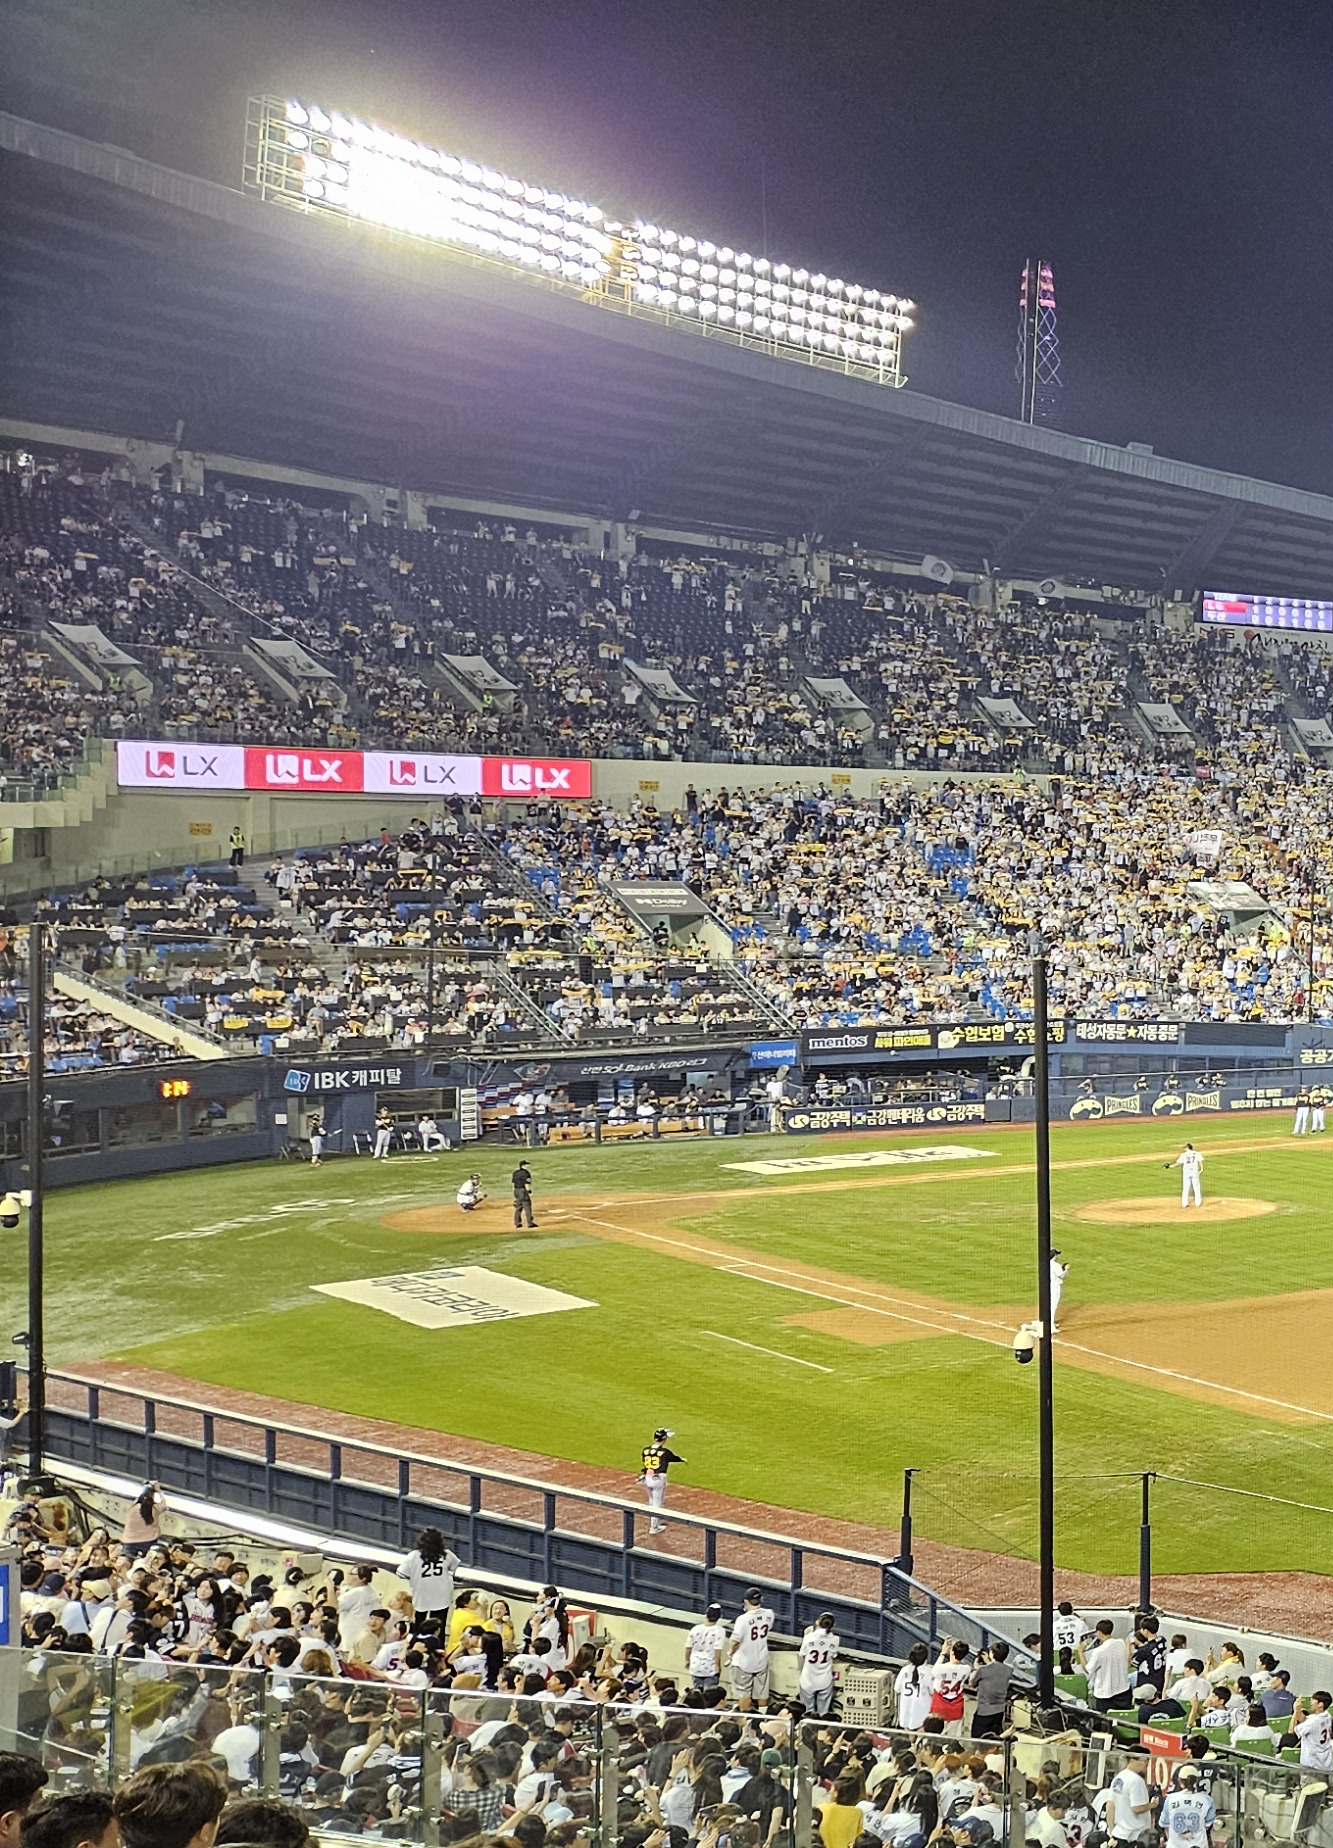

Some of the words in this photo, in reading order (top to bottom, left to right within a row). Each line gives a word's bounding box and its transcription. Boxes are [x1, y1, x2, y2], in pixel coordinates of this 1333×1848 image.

[183, 756, 219, 776] LX
[302, 759, 342, 782] LX
[424, 764, 456, 784] LX
[533, 766, 571, 789] LX
[809, 1034, 868, 1050] mentos
[624, 1062, 656, 1073] Bank
[657, 1061, 685, 1070] KBO
[1106, 1097, 1138, 1112] PRINGLES
[1187, 1094, 1218, 1109] PRINGLES
[809, 1111, 850, 1129] 금강주택
[947, 1104, 985, 1123] 금강주택
[644, 1456, 660, 1469] 83
[421, 1561, 443, 1578] 25
[750, 1624, 769, 1641] 63
[1058, 1632, 1075, 1645] 53
[808, 1650, 829, 1665] 31
[940, 1680, 962, 1696] 54
[1173, 1812, 1200, 1834] 63
